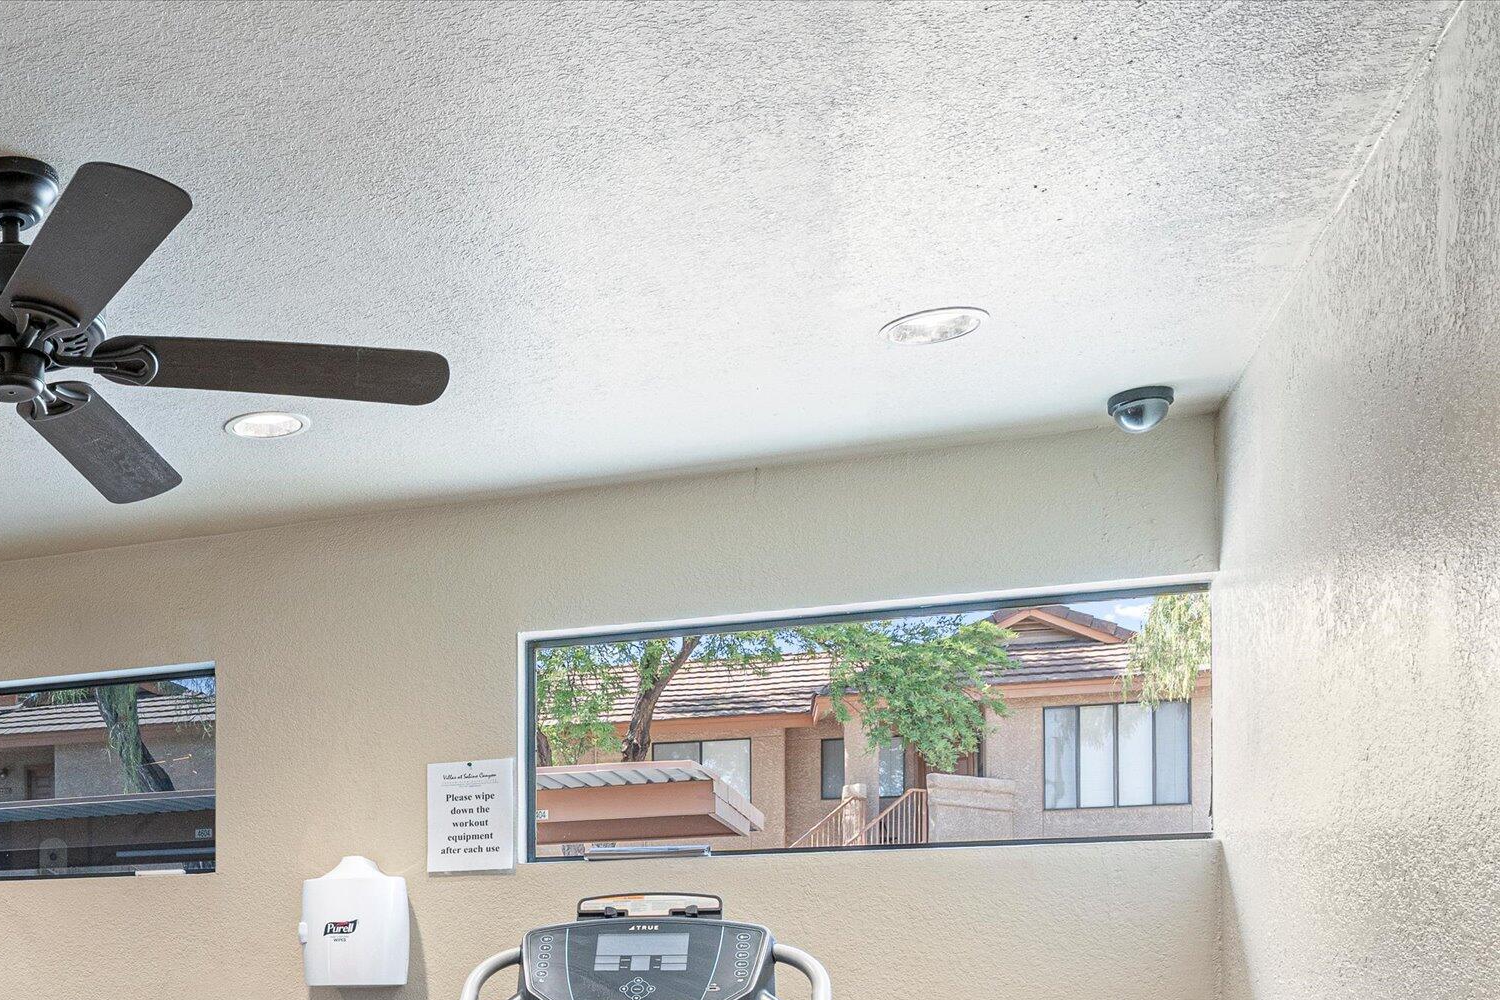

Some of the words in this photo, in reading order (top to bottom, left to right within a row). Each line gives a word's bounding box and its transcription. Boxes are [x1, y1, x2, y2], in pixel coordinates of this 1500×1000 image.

[446, 793, 473, 802] Please
[474, 791, 496, 802] wipe
[450, 807, 474, 815] down
[476, 805, 490, 814] the
[452, 819, 489, 828] workout
[447, 832, 494, 843] equipment
[440, 846, 462, 855] after
[463, 845, 483, 854] each
